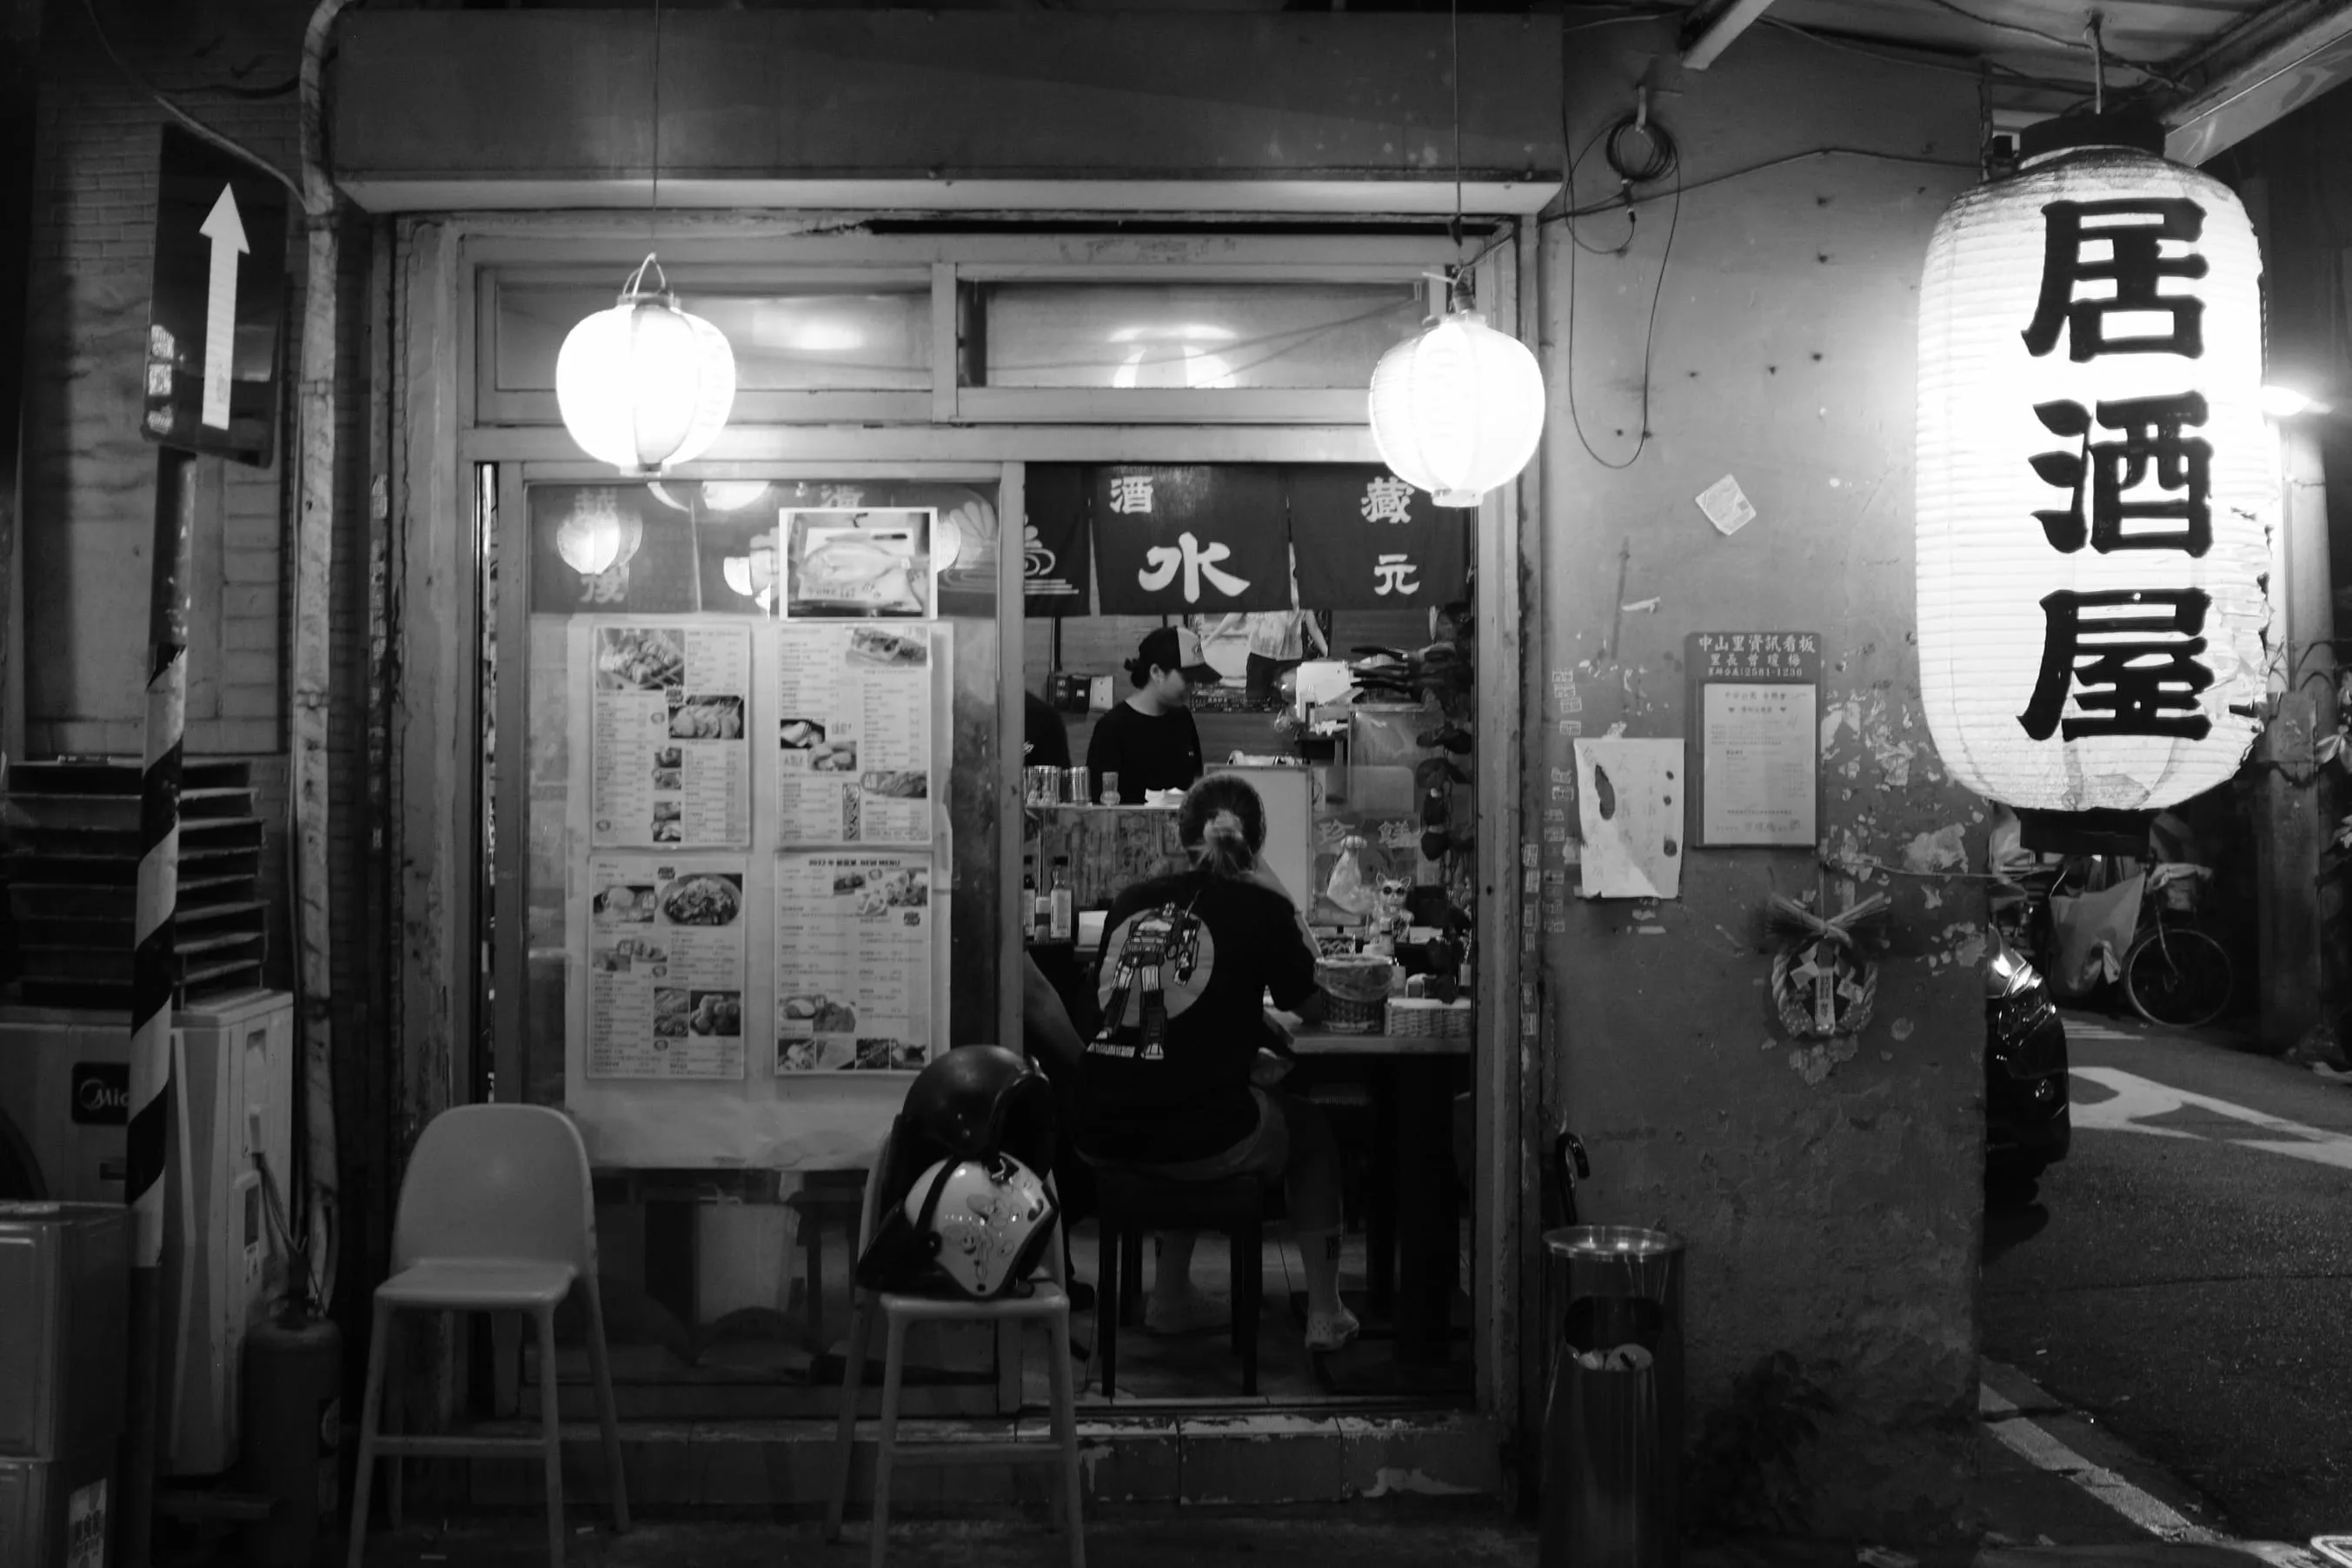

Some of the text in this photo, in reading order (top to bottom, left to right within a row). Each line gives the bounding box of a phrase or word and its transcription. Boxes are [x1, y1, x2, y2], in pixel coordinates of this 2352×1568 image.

[2016, 196, 2216, 743] 居酒屋
[1109, 475, 1154, 515] 酒
[1138, 530, 1252, 604] 水
[1697, 633, 1817, 654] 中山里資訊看板
[860, 858, 877, 867] NEW
[878, 858, 900, 867] MENU
